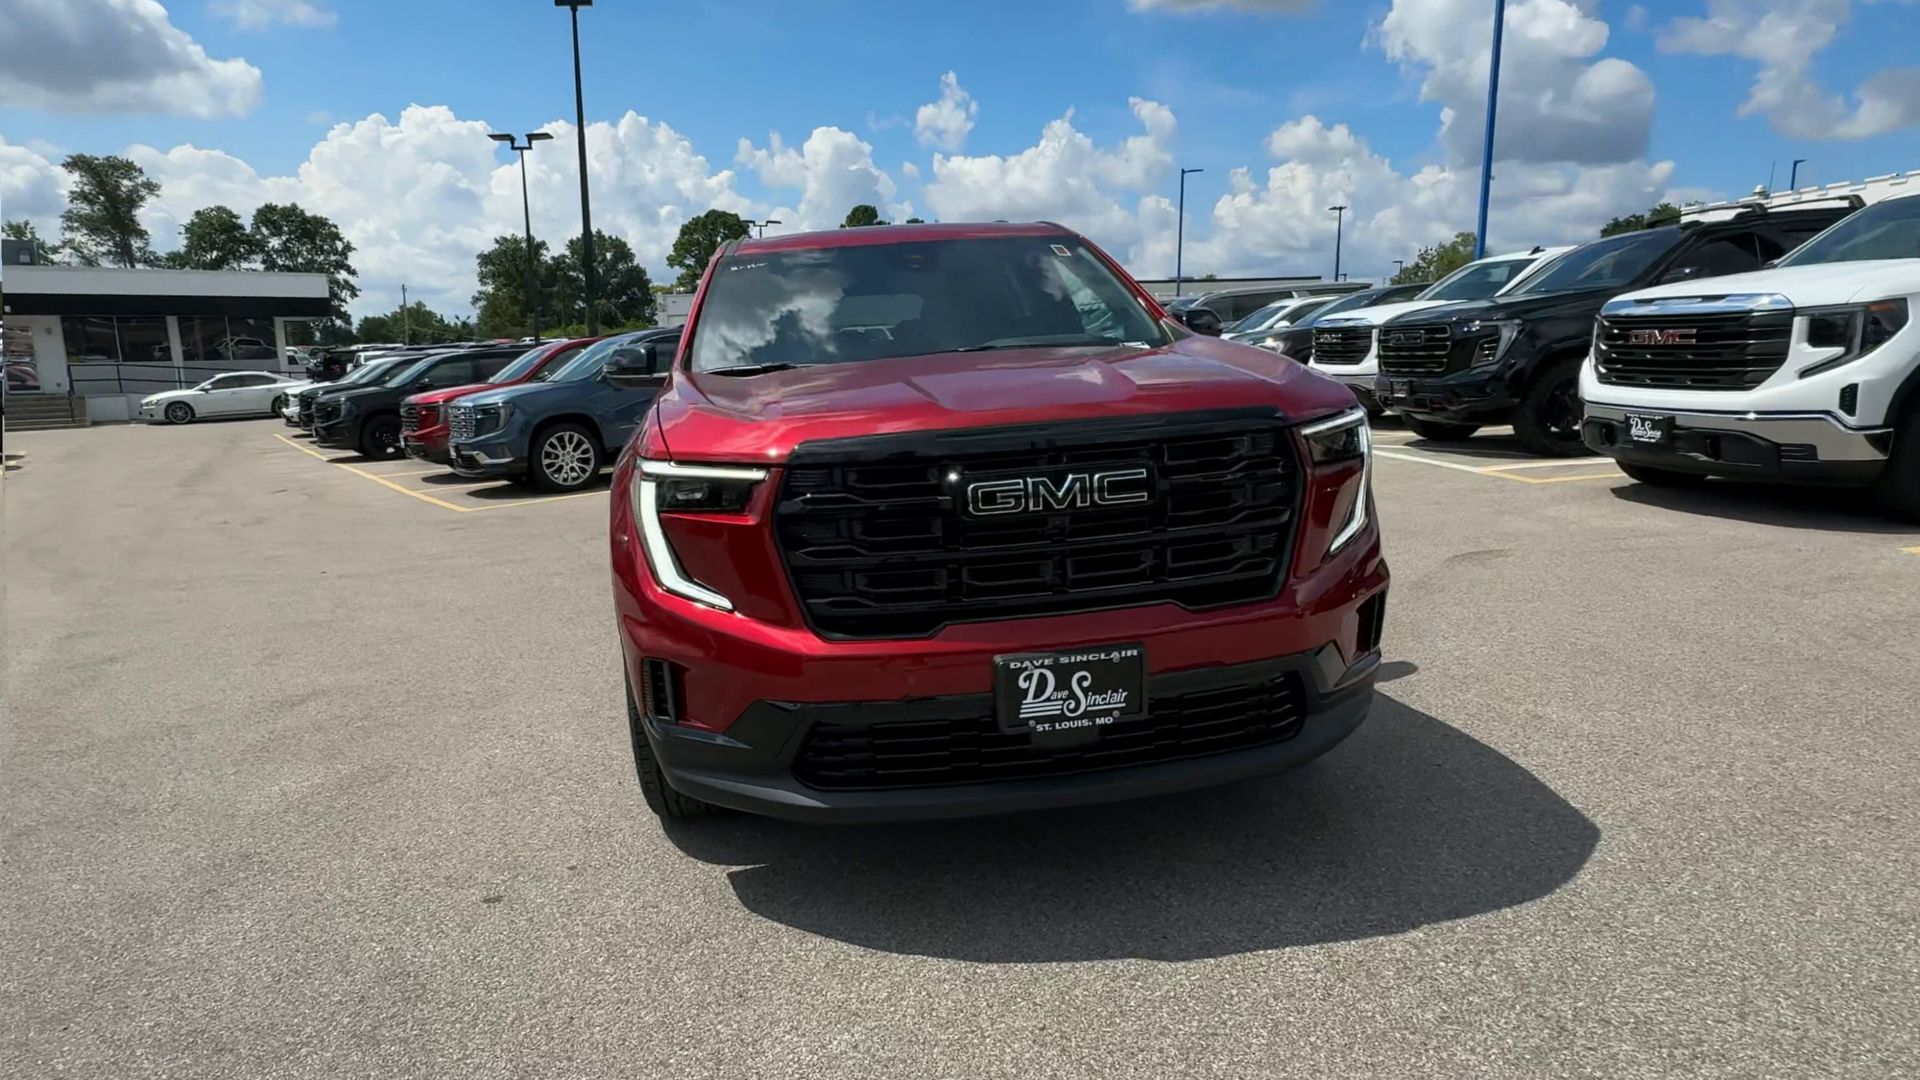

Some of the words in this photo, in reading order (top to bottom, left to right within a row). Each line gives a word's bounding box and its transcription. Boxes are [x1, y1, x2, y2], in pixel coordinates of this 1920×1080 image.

[1629, 328, 1697, 345] GMC
[967, 469, 1148, 516] GMC
[1009, 658, 1054, 670] DAVE
[1059, 649, 1138, 664] SINCLAIR
[1018, 667, 1069, 704] Dave
[1063, 670, 1128, 718] Sinclair
[1036, 722, 1053, 732] ST.
[1095, 716, 1114, 725] MO
